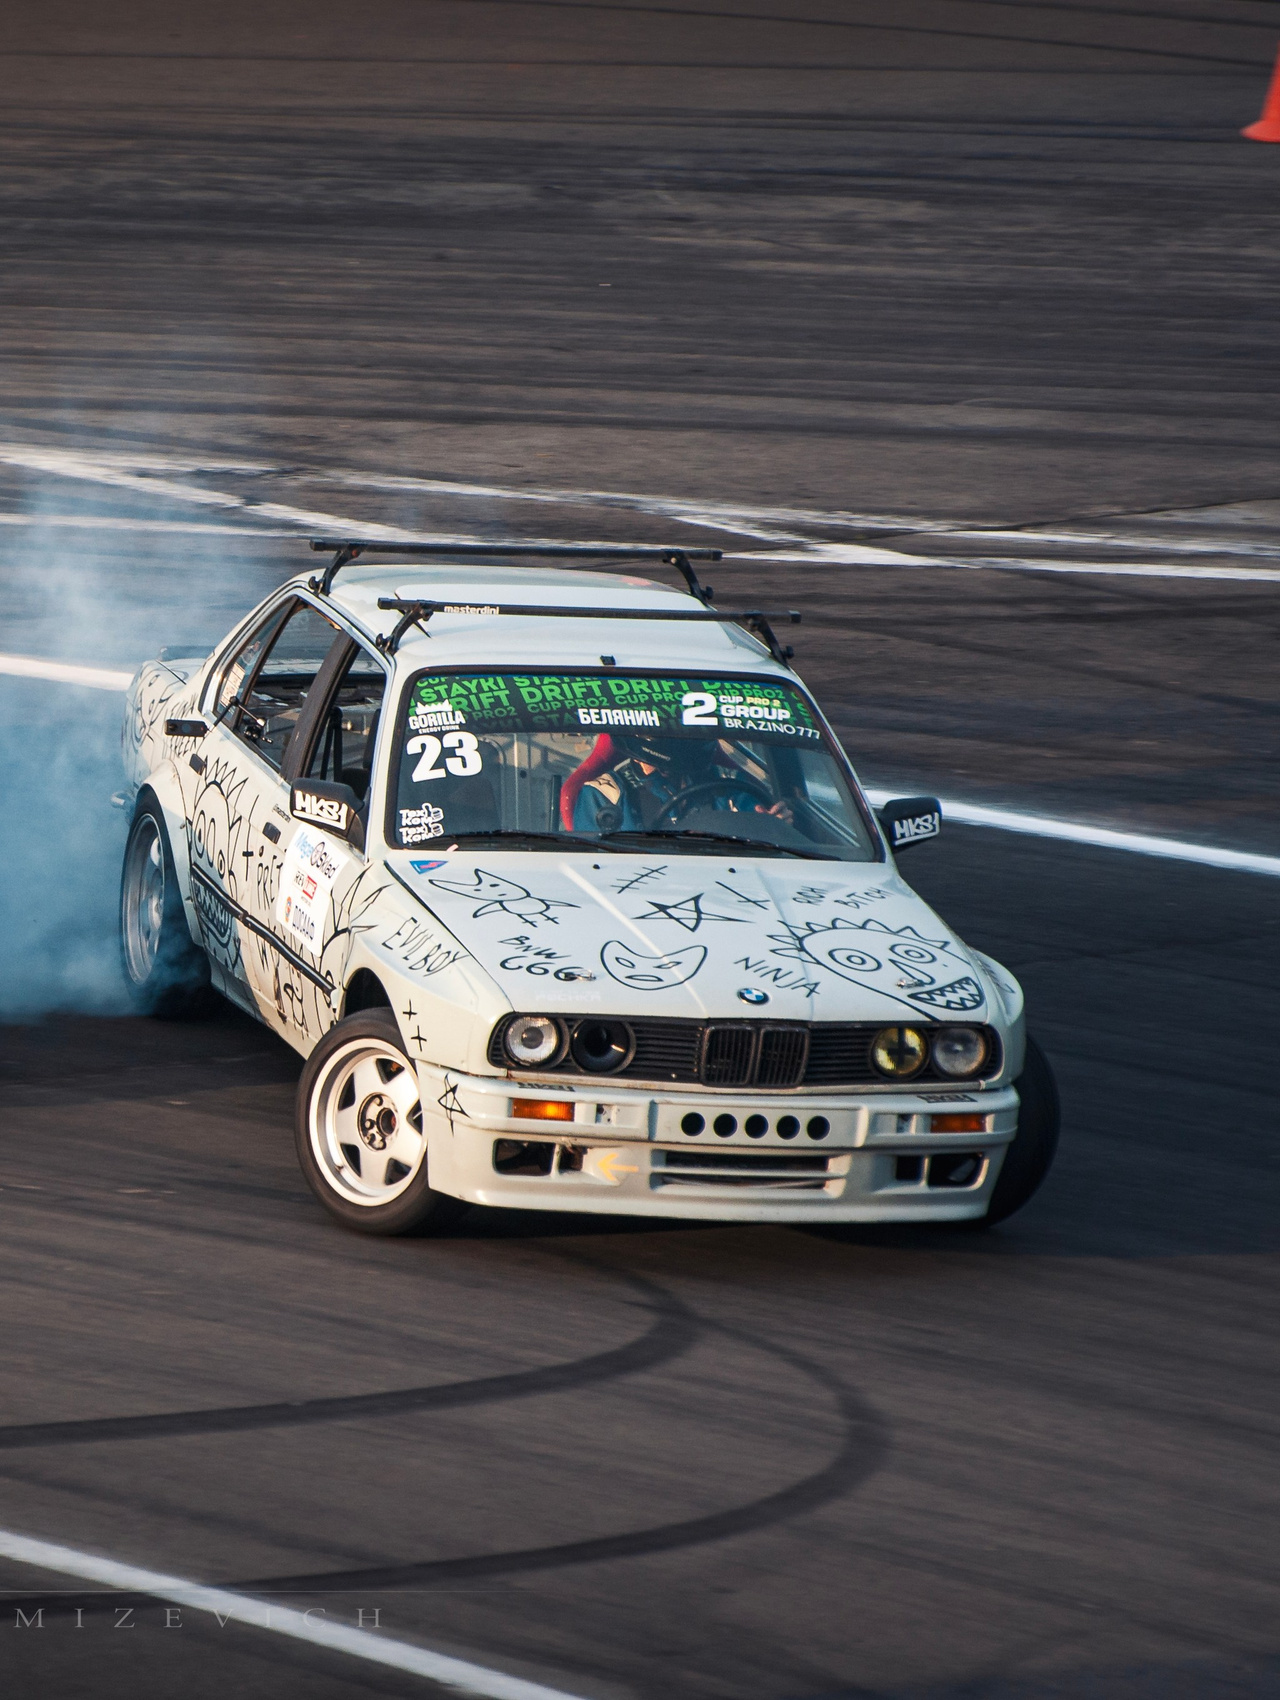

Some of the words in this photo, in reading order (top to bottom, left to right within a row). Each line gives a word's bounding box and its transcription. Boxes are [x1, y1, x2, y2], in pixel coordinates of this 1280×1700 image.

[520, 680, 603, 704] DRIFT
[526, 701, 561, 713] CUP
[564, 696, 609, 710] PRO2
[614, 692, 649, 705] CUP
[718, 694, 744, 704] CUP
[746, 696, 770, 706] PRO
[771, 698, 782, 708] 2
[408, 710, 466, 730] GORILLA
[577, 708, 661, 727] БЕЛЯНИН
[681, 691, 719, 726] 2
[720, 704, 791, 721] GROUP
[724, 717, 821, 740] BRAZINO777
[405, 731, 483, 783] 23
[381, 916, 434, 961] EVIL
[408, 942, 470, 977] BOY
[733, 956, 821, 998] NINJA
